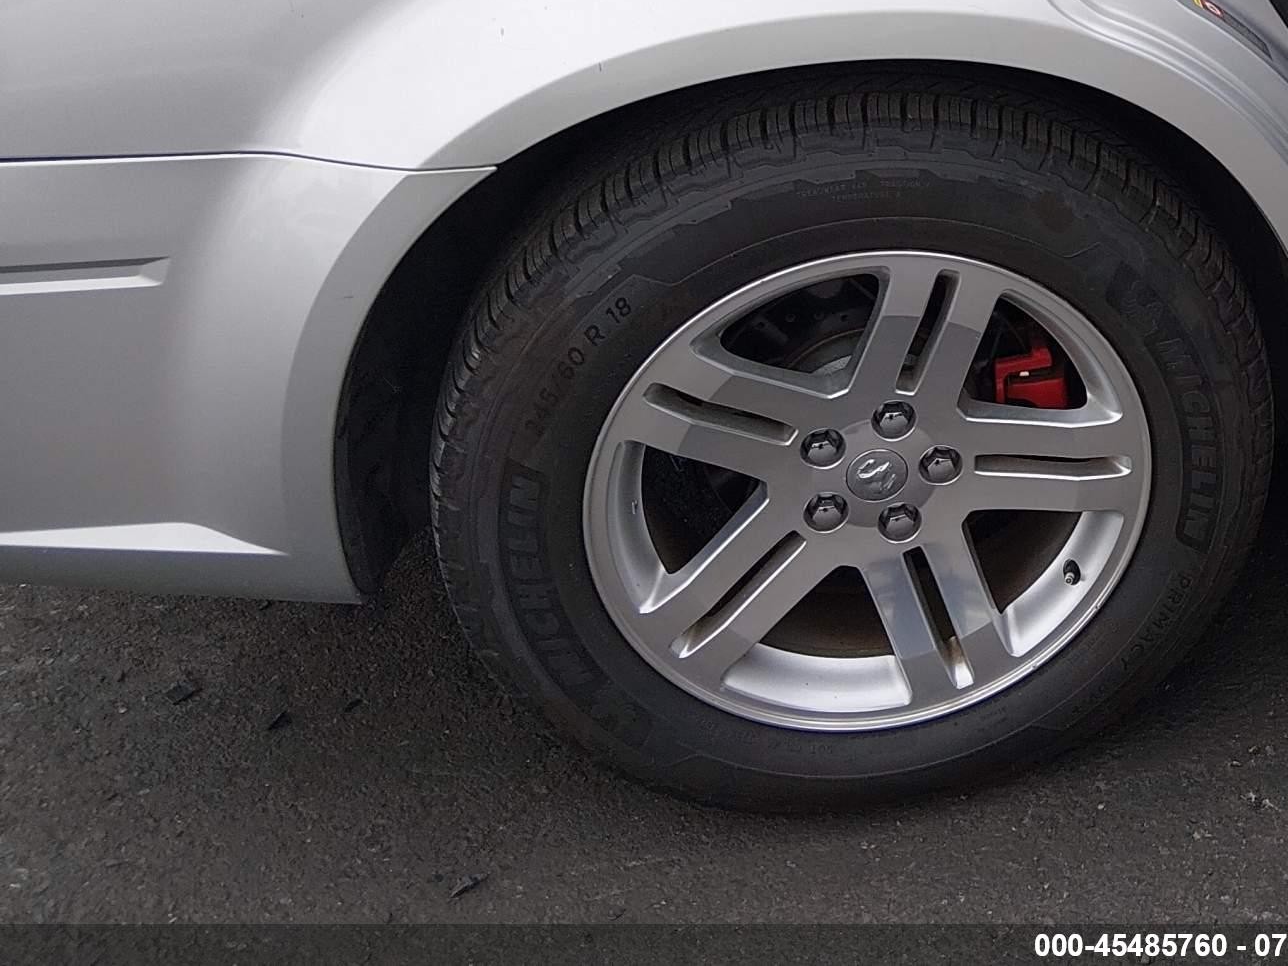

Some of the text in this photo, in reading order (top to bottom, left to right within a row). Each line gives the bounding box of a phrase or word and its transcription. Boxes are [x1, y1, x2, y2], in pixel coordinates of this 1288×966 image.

[583, 324, 606, 347] R
[605, 296, 632, 324] 18
[1156, 337, 1217, 539] MICHELIN
[506, 474, 600, 685] MICHELIN
[1120, 572, 1194, 672] PRIMACY
